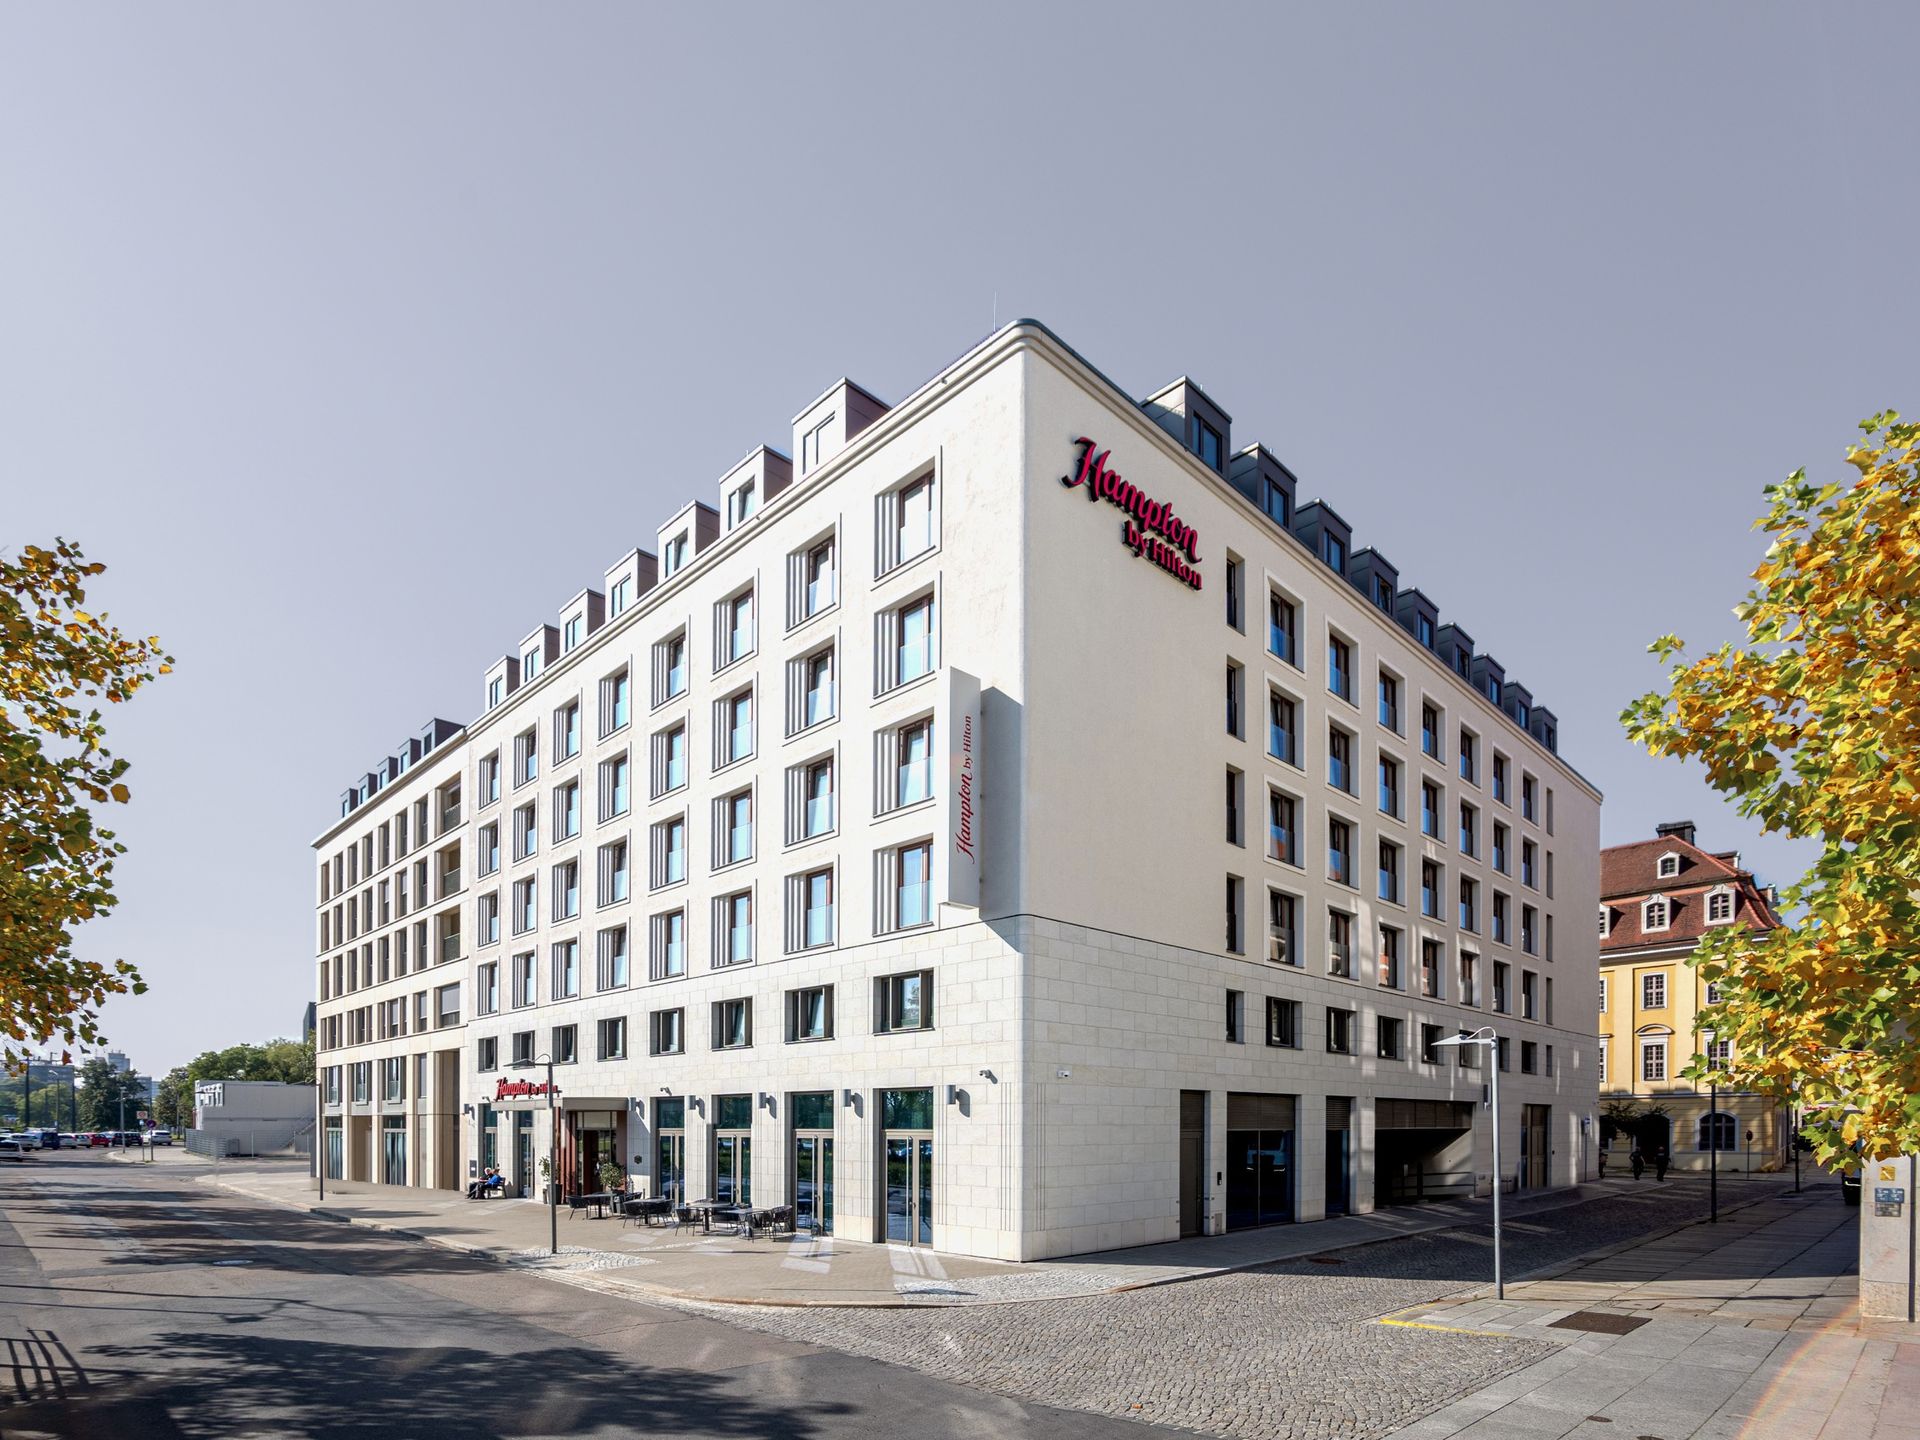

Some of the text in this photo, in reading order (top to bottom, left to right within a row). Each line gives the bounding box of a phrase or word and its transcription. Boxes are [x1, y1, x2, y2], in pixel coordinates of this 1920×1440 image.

[1061, 436, 1202, 564] Hampton
[1124, 520, 1203, 590] by Hilton
[955, 715, 975, 865] Hampton by Hilton
[494, 1077, 531, 1102] Hampton
